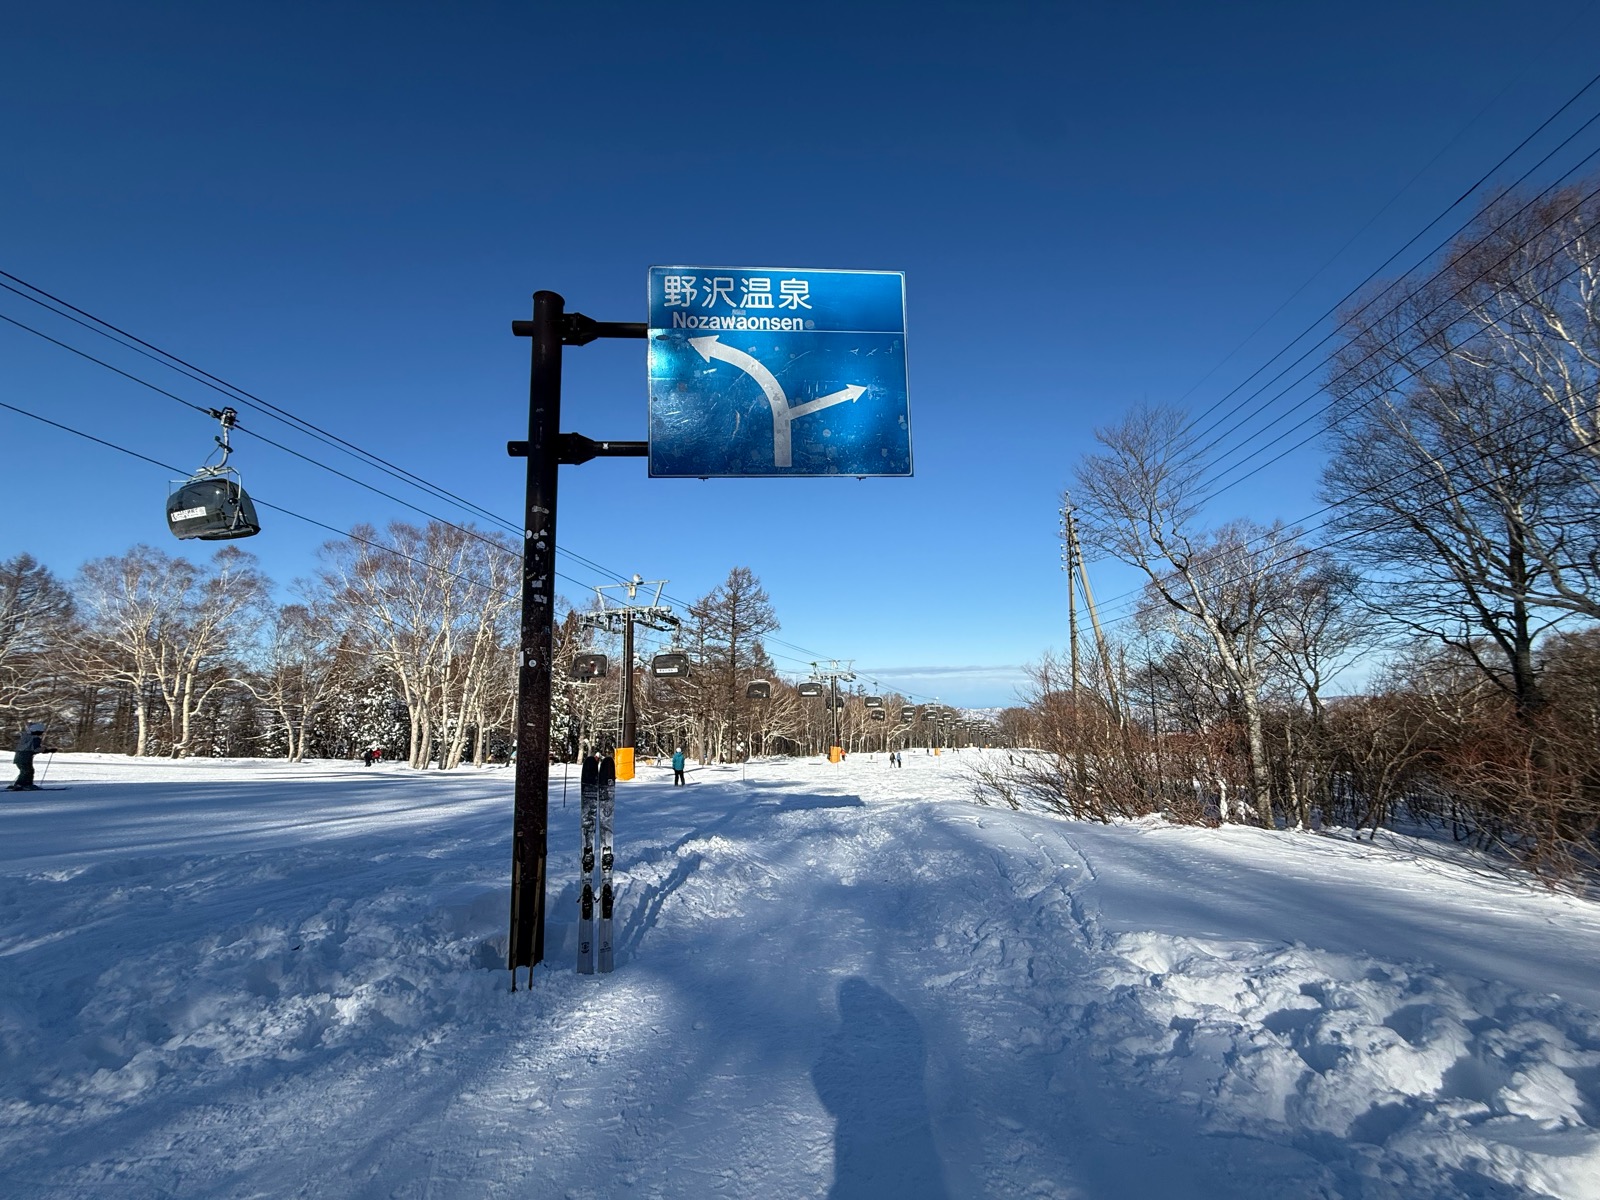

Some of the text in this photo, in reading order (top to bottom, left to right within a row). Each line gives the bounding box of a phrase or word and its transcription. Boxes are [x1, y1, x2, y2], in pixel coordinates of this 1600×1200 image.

[663, 275, 813, 310] 野沢温泉
[672, 311, 804, 331] Nozawaonsen
